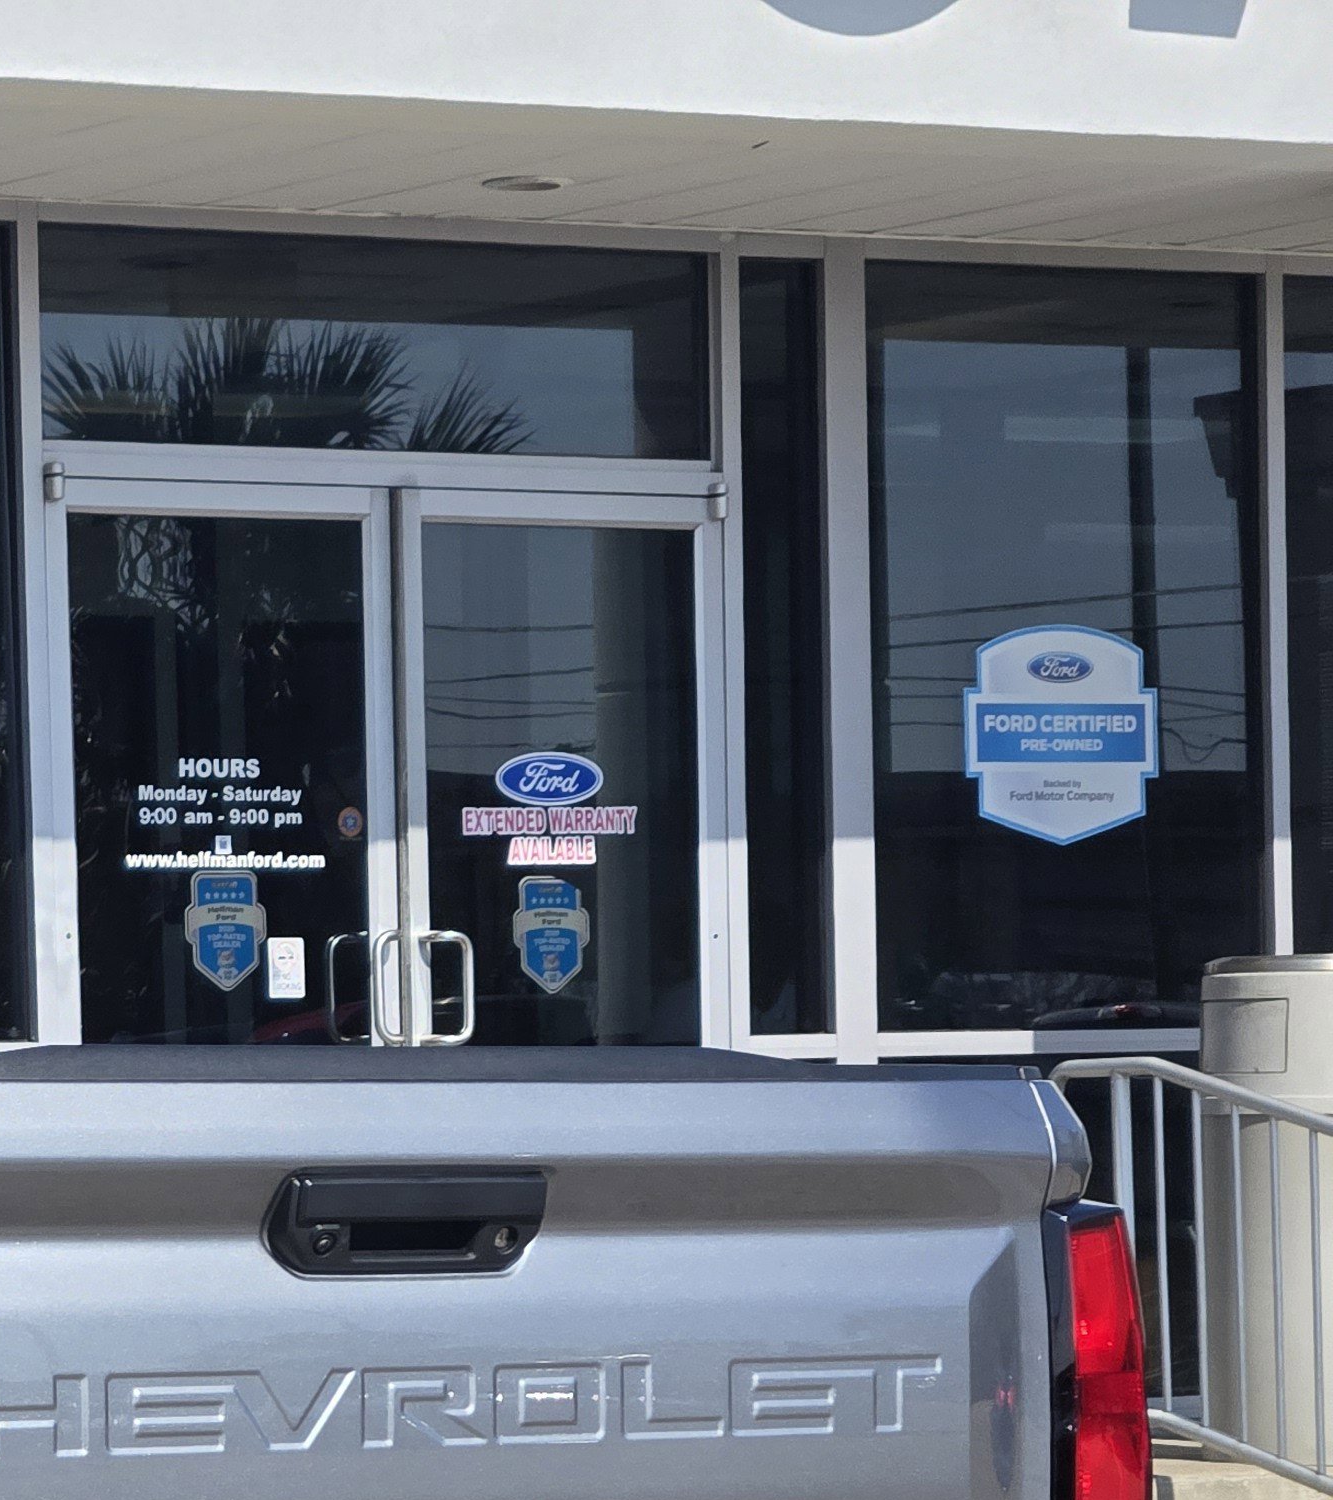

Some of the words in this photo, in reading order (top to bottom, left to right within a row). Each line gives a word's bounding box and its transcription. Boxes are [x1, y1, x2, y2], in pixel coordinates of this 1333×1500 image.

[1040, 656, 1080, 678] Ford
[983, 714, 1037, 733] FORD
[1039, 714, 1137, 734] CERTIFIED
[1020, 738, 1103, 752] PRE-OWNED
[178, 757, 261, 779] HOURS
[518, 761, 581, 793] Ford
[137, 784, 208, 806] Monday
[222, 785, 303, 806] Saturday
[1043, 779, 1071, 788] Backed
[1072, 779, 1081, 790] by
[1009, 790, 1033, 801] Ford
[1034, 790, 1065, 801] Motor
[1066, 790, 1114, 802] Company
[138, 807, 177, 825] 9:00
[183, 811, 213, 825] am
[229, 808, 269, 825] 9:00
[274, 811, 303, 829] pm
[464, 808, 545, 833] EXTENDED
[549, 808, 636, 833] WARRANTY
[125, 850, 326, 869] www.helfmanford.com
[511, 837, 594, 862] AVAILABLE
